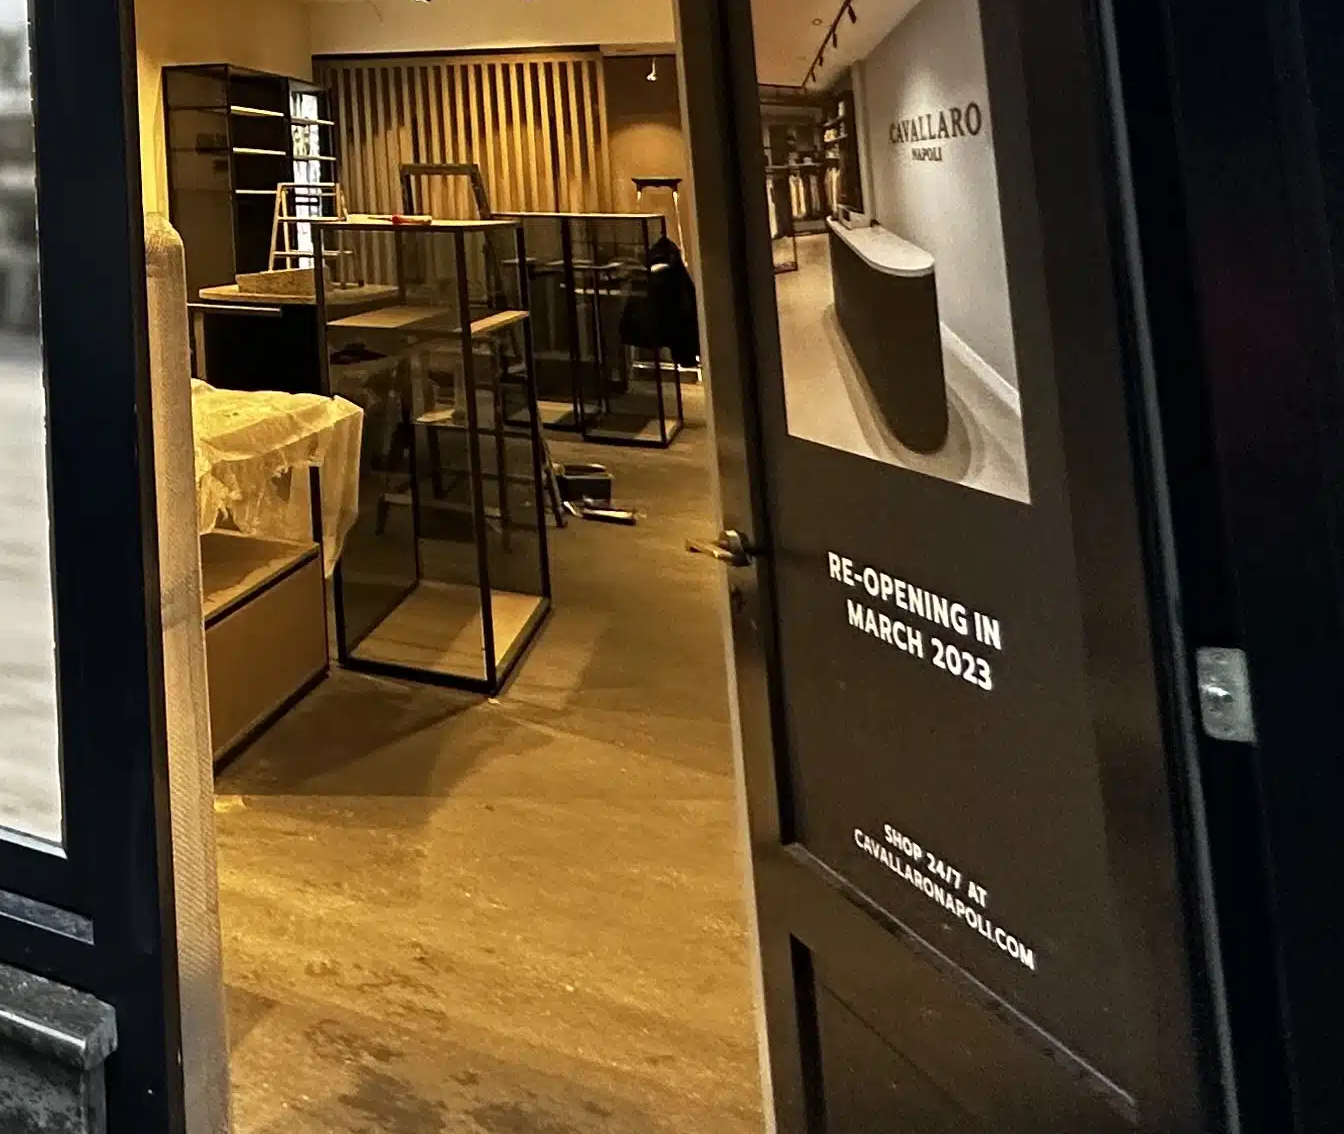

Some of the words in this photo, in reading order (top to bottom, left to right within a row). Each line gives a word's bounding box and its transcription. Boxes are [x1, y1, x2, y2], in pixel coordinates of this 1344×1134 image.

[889, 102, 982, 144] CAVALLARO
[911, 147, 943, 162] NAPOLI
[828, 551, 968, 635] RE-OPENING
[975, 611, 1002, 650] IN
[847, 598, 924, 659] MARCH
[931, 637, 993, 691] 2023
[854, 828, 1035, 970] CAVALLARONAPOLI.COM
[884, 824, 923, 861] SHOP
[926, 852, 962, 889] 24/7
[968, 881, 988, 908] AT
